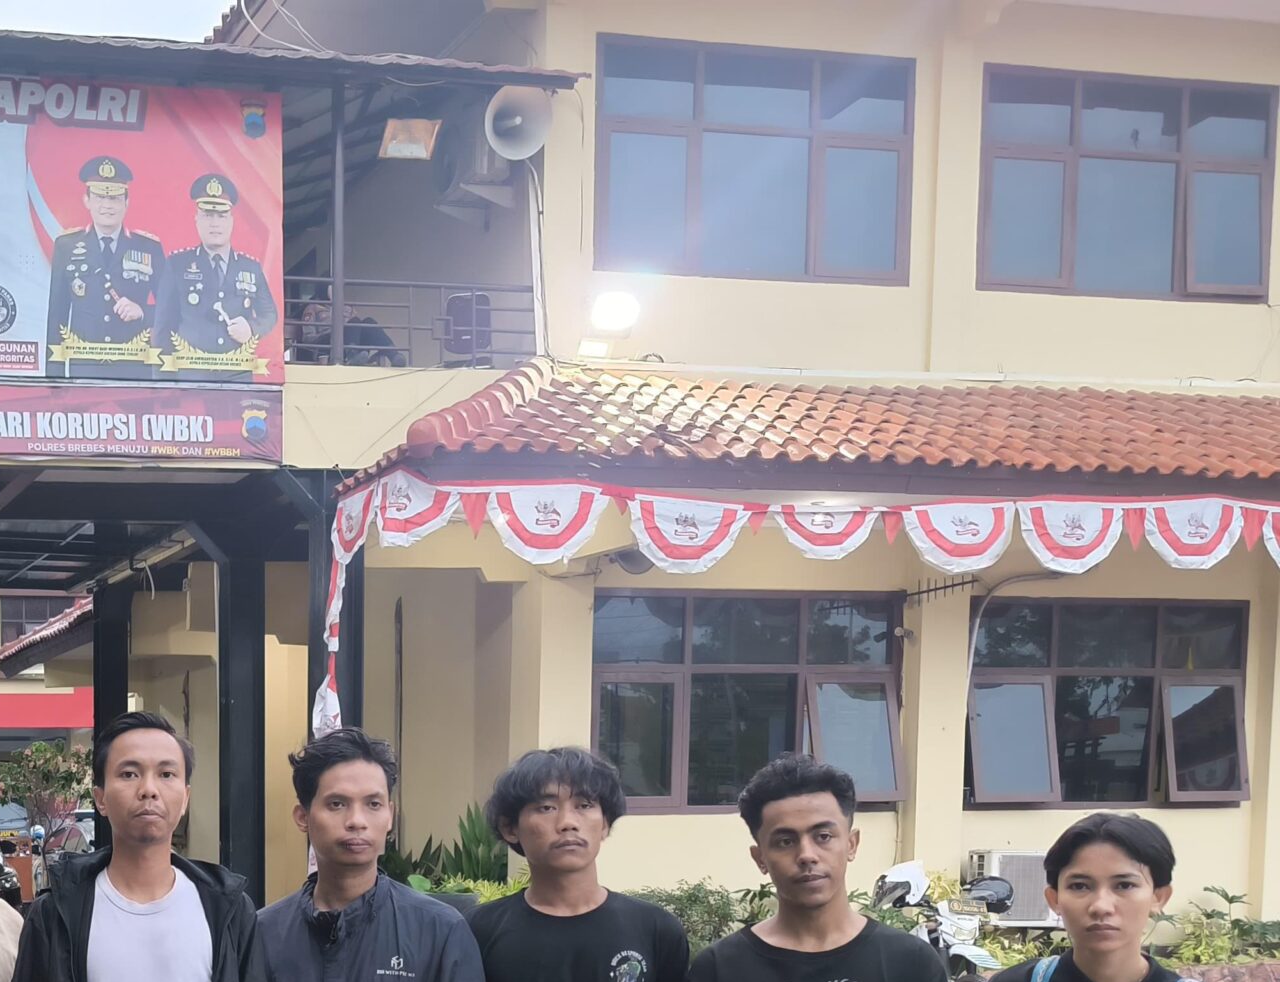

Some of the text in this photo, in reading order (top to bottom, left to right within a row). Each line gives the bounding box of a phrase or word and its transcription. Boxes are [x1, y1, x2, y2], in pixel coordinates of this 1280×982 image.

[36, 412, 136, 441] KORUPSI
[142, 415, 214, 442] (WBK)
[27, 443, 240, 456] POLRES BREBES MENUJU #WBK DAN #WBBM
